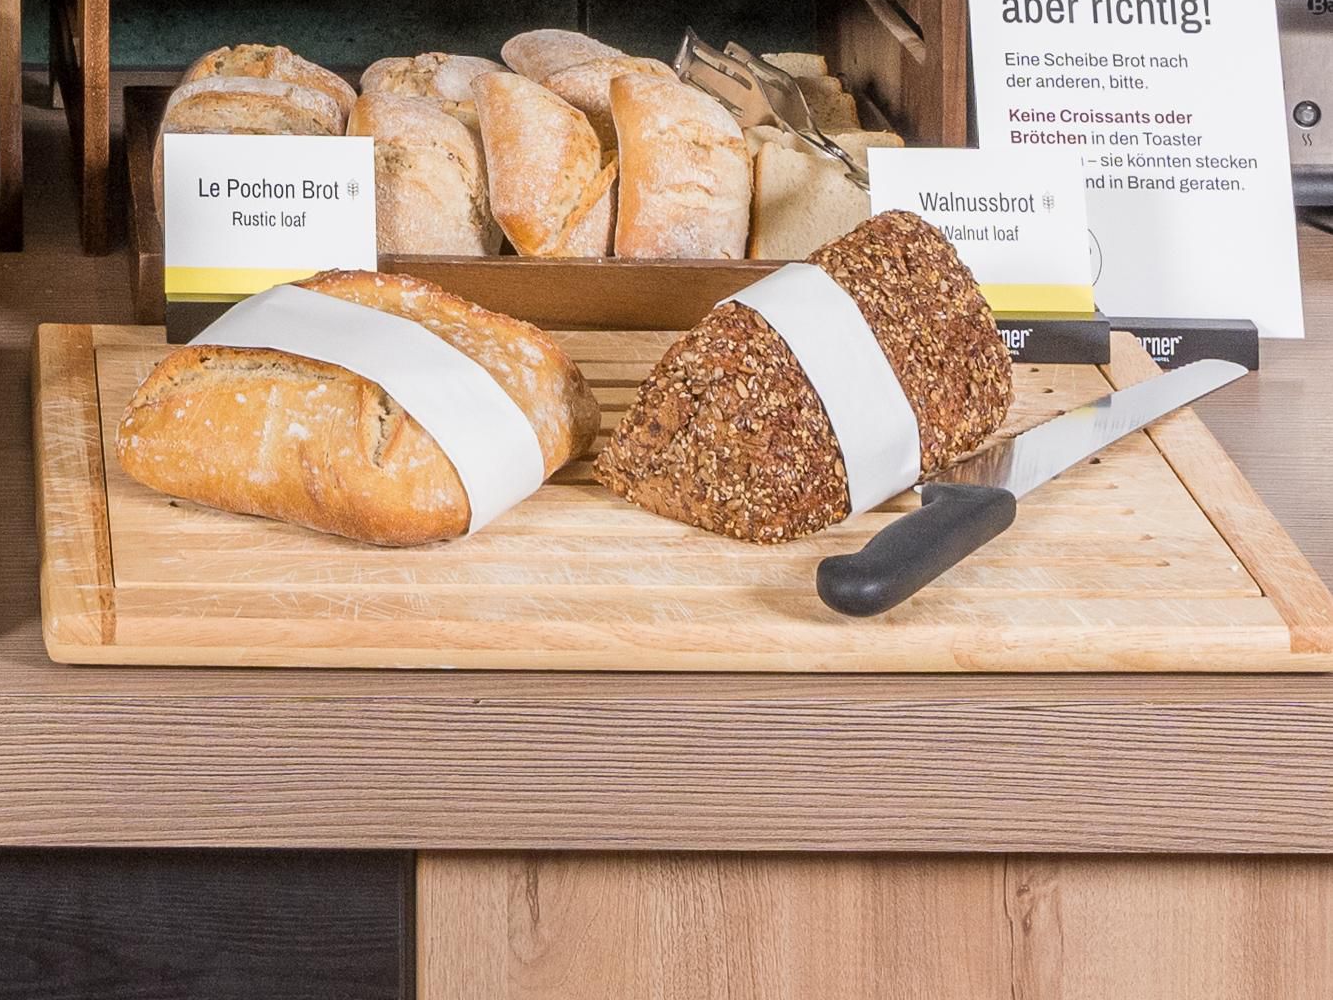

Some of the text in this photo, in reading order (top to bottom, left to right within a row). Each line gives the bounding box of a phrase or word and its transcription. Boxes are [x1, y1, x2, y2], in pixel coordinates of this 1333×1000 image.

[1004, 51, 1189, 68] Eine Scheibe Brot nach
[1006, 73, 1148, 90] der anderen, bitte.
[1008, 108, 1193, 125] Keine Croissants oder
[1010, 130, 1203, 147] Brötchen in den Toaster
[1100, 152, 1123, 168] sie
[1127, 153, 1192, 168] könnten
[1195, 154, 1258, 169] stecken
[198, 177, 340, 200] Le Pochon Brot
[1085, 174, 1245, 194] nd in Brand geraten.
[918, 191, 1036, 213] Walnussbrot
[232, 210, 307, 228] Rustic loaf
[993, 225, 1019, 242] loaf
